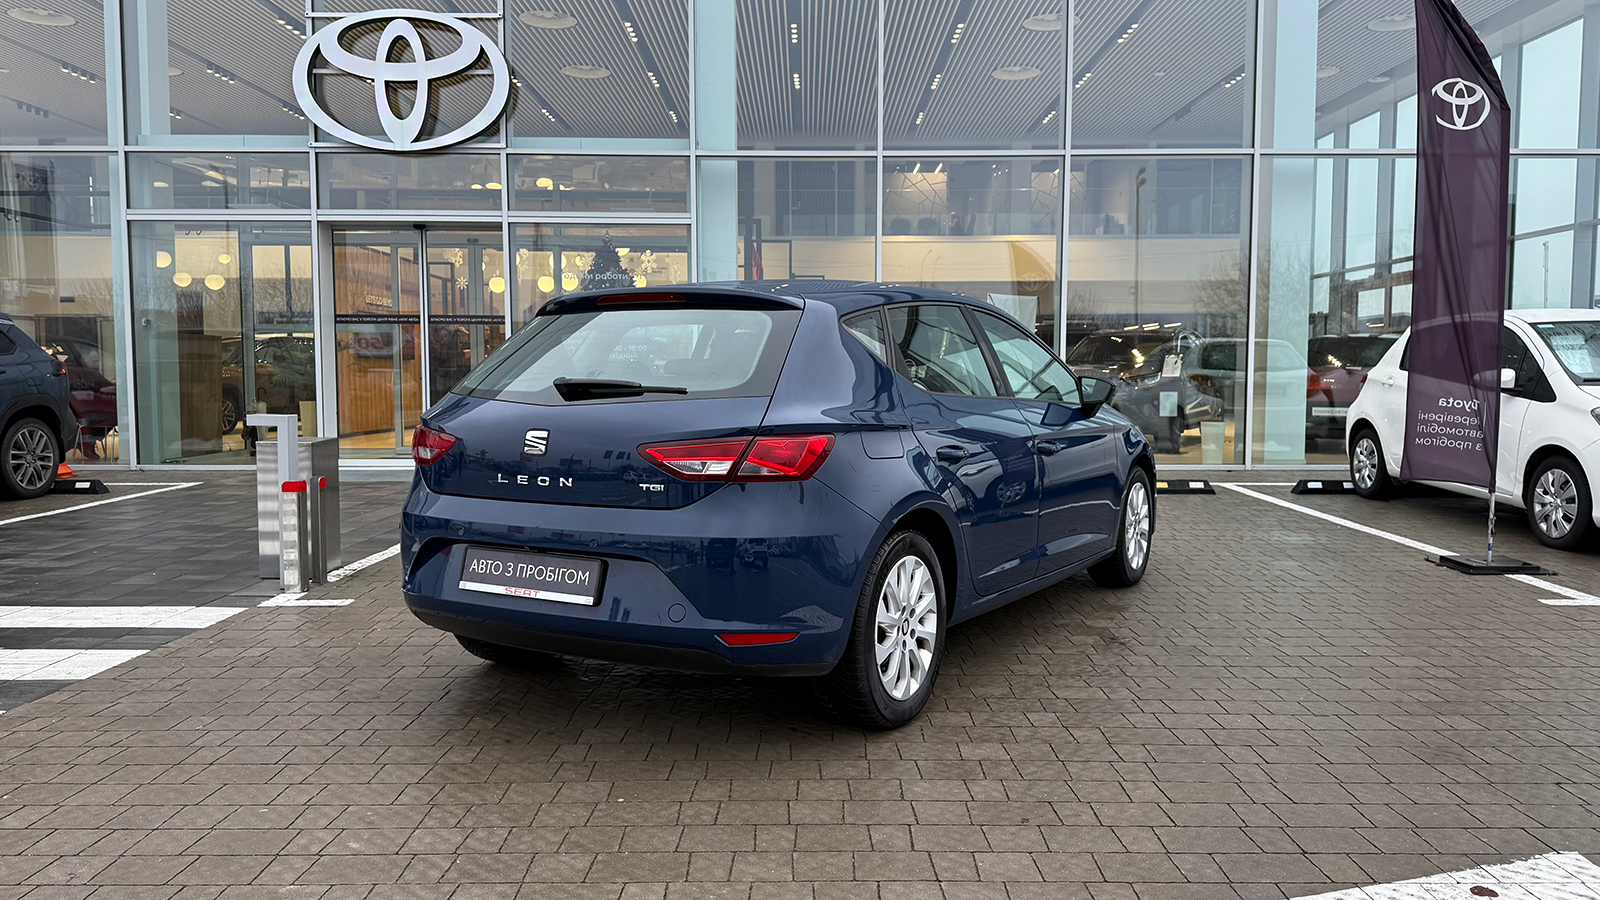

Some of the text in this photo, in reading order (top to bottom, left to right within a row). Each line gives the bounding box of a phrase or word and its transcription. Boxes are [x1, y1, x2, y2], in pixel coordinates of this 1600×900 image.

[497, 473, 573, 488] LEON
[638, 483, 665, 492] TGI
[469, 558, 503, 576] АВТО
[516, 563, 590, 586] ПРОБІГОМ
[504, 586, 541, 598] SEAT
